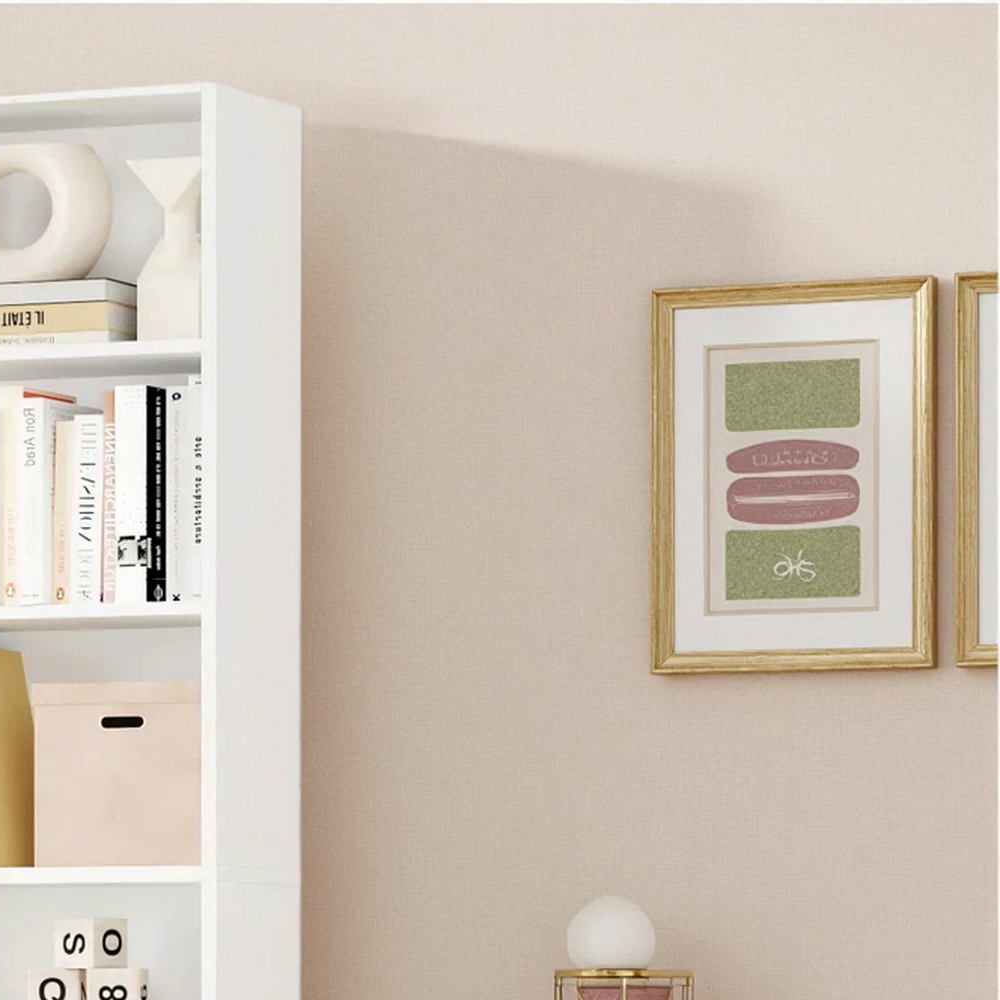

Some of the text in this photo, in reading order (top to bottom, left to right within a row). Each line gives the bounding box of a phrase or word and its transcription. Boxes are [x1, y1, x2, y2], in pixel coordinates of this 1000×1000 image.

[1, 310, 32, 329] ÉTAIT
[35, 310, 45, 325] IL
[63, 933, 85, 954] S
